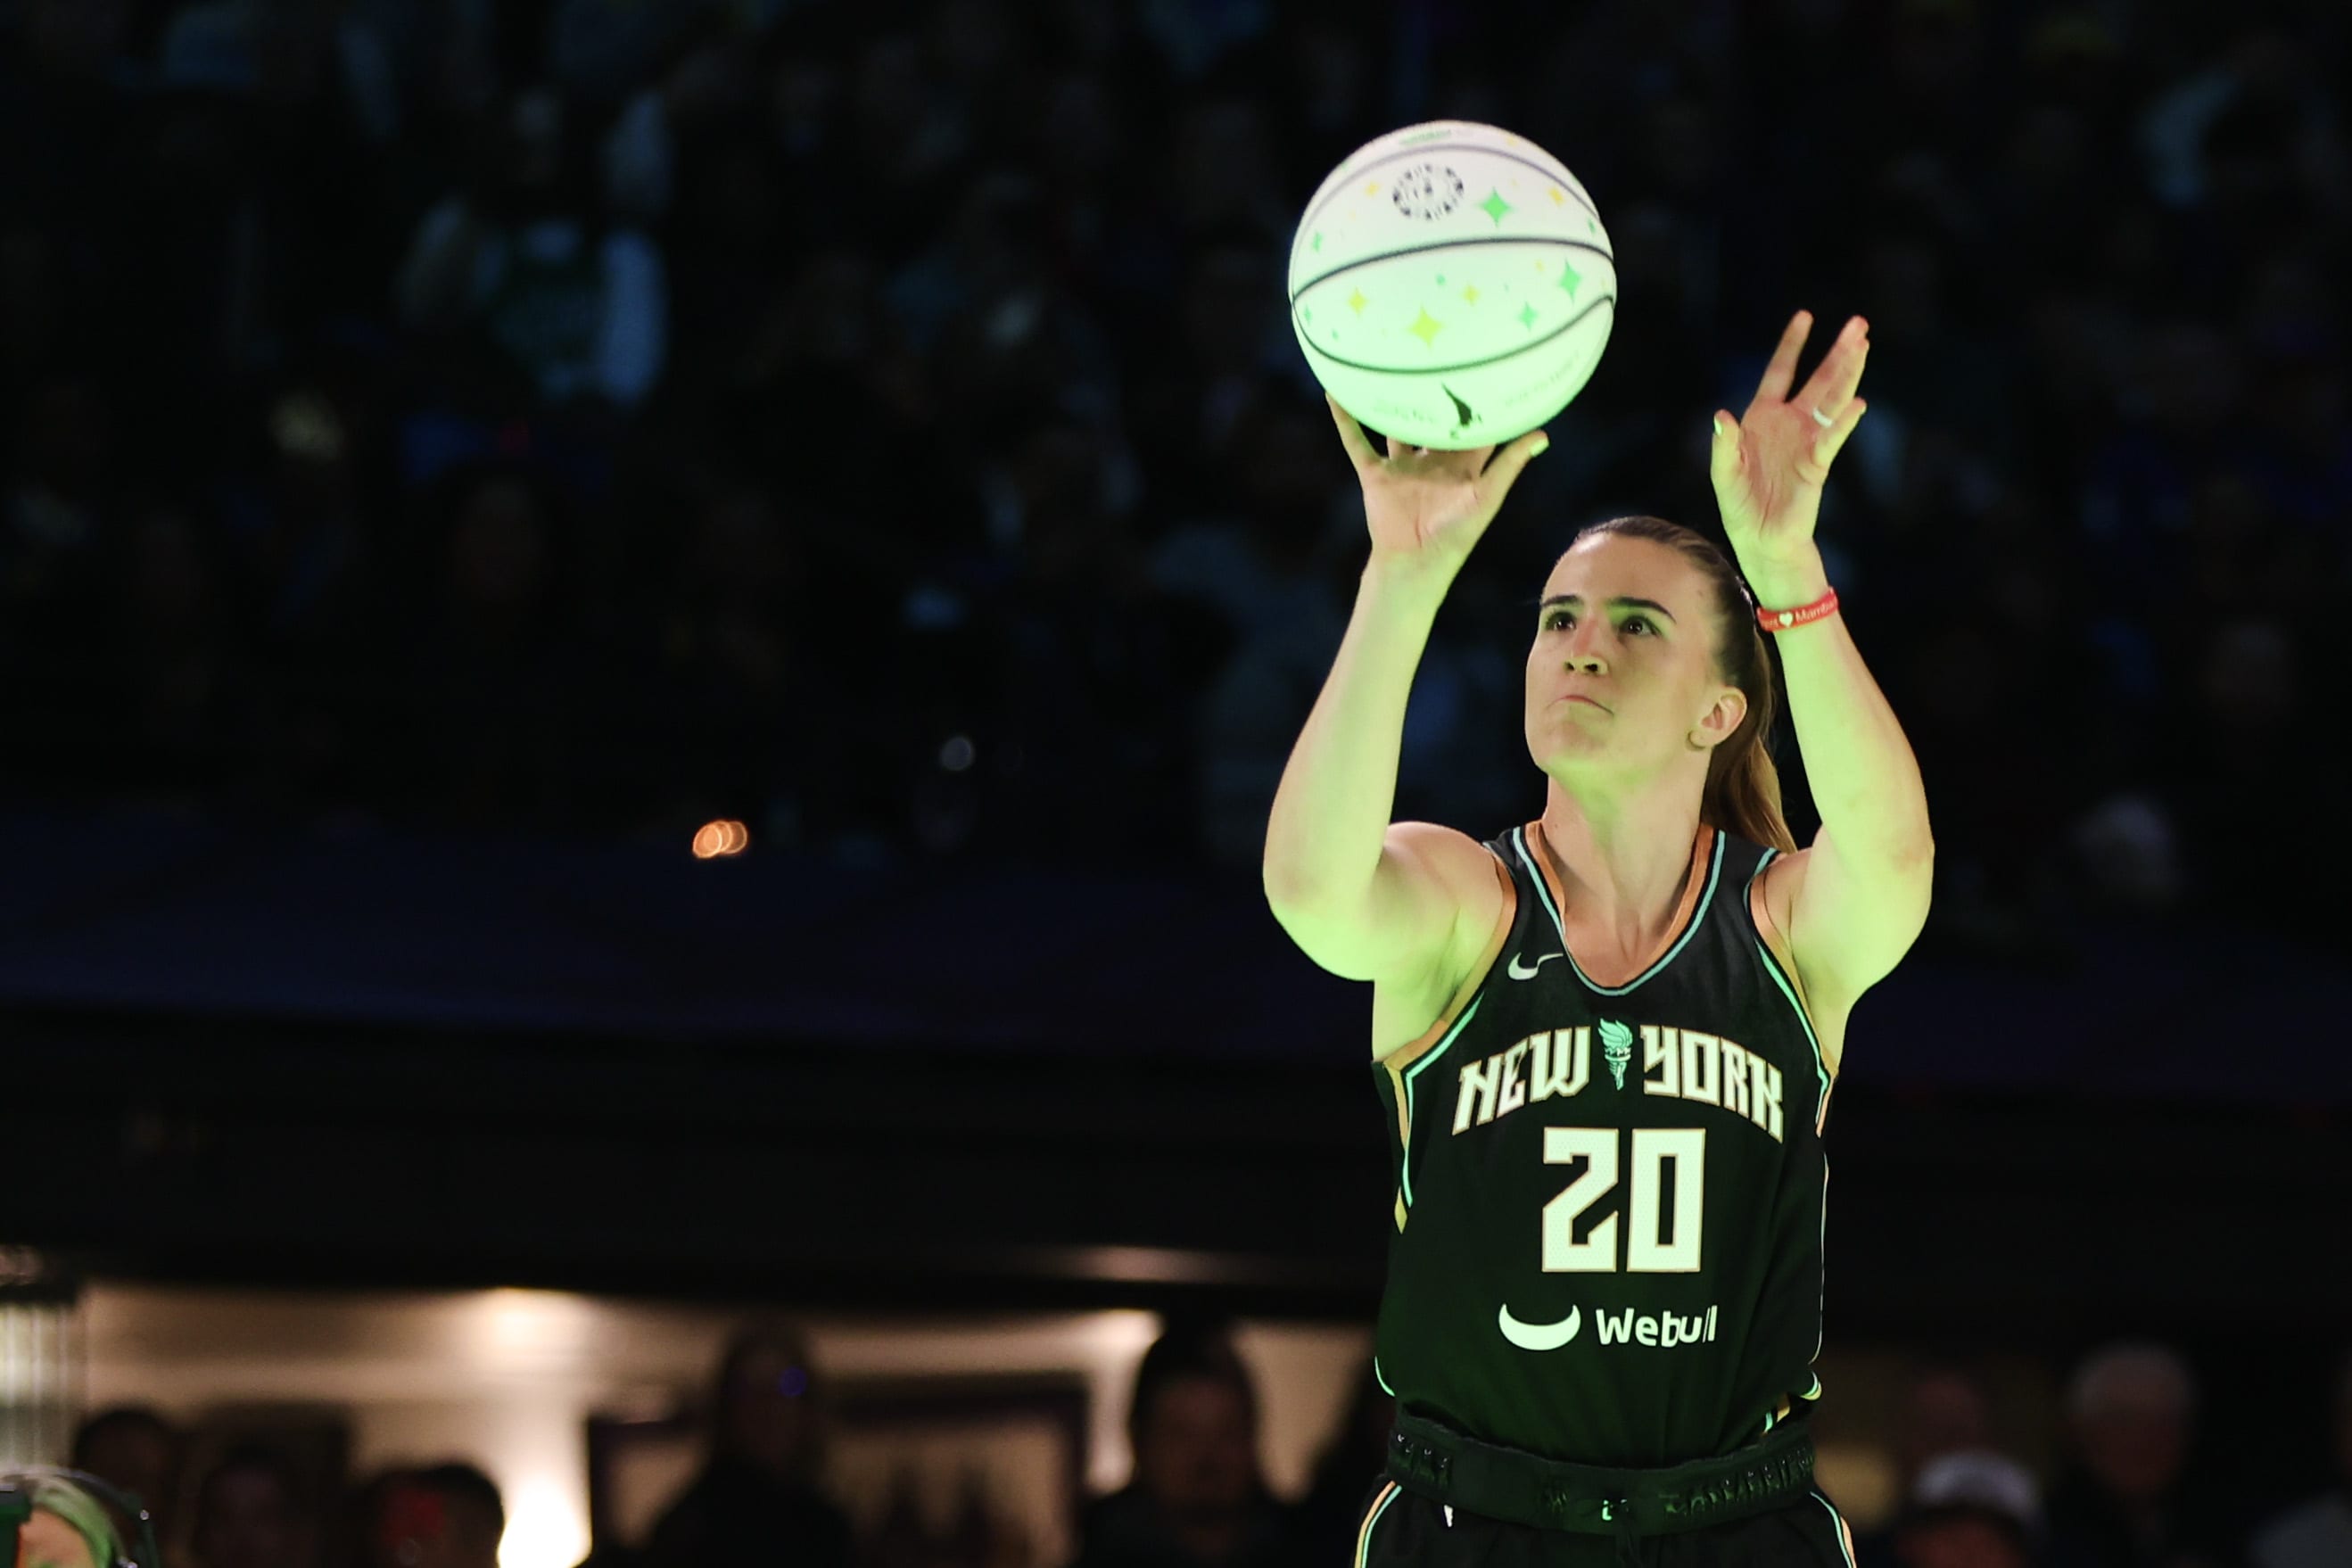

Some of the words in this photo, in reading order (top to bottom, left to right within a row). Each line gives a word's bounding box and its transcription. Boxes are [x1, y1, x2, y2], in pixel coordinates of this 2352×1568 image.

[1451, 1026, 1591, 1135] NEW
[1639, 1025, 1784, 1143] YORK
[1541, 1126, 1706, 1273] 20
[1596, 1305, 1718, 1348] Webull
